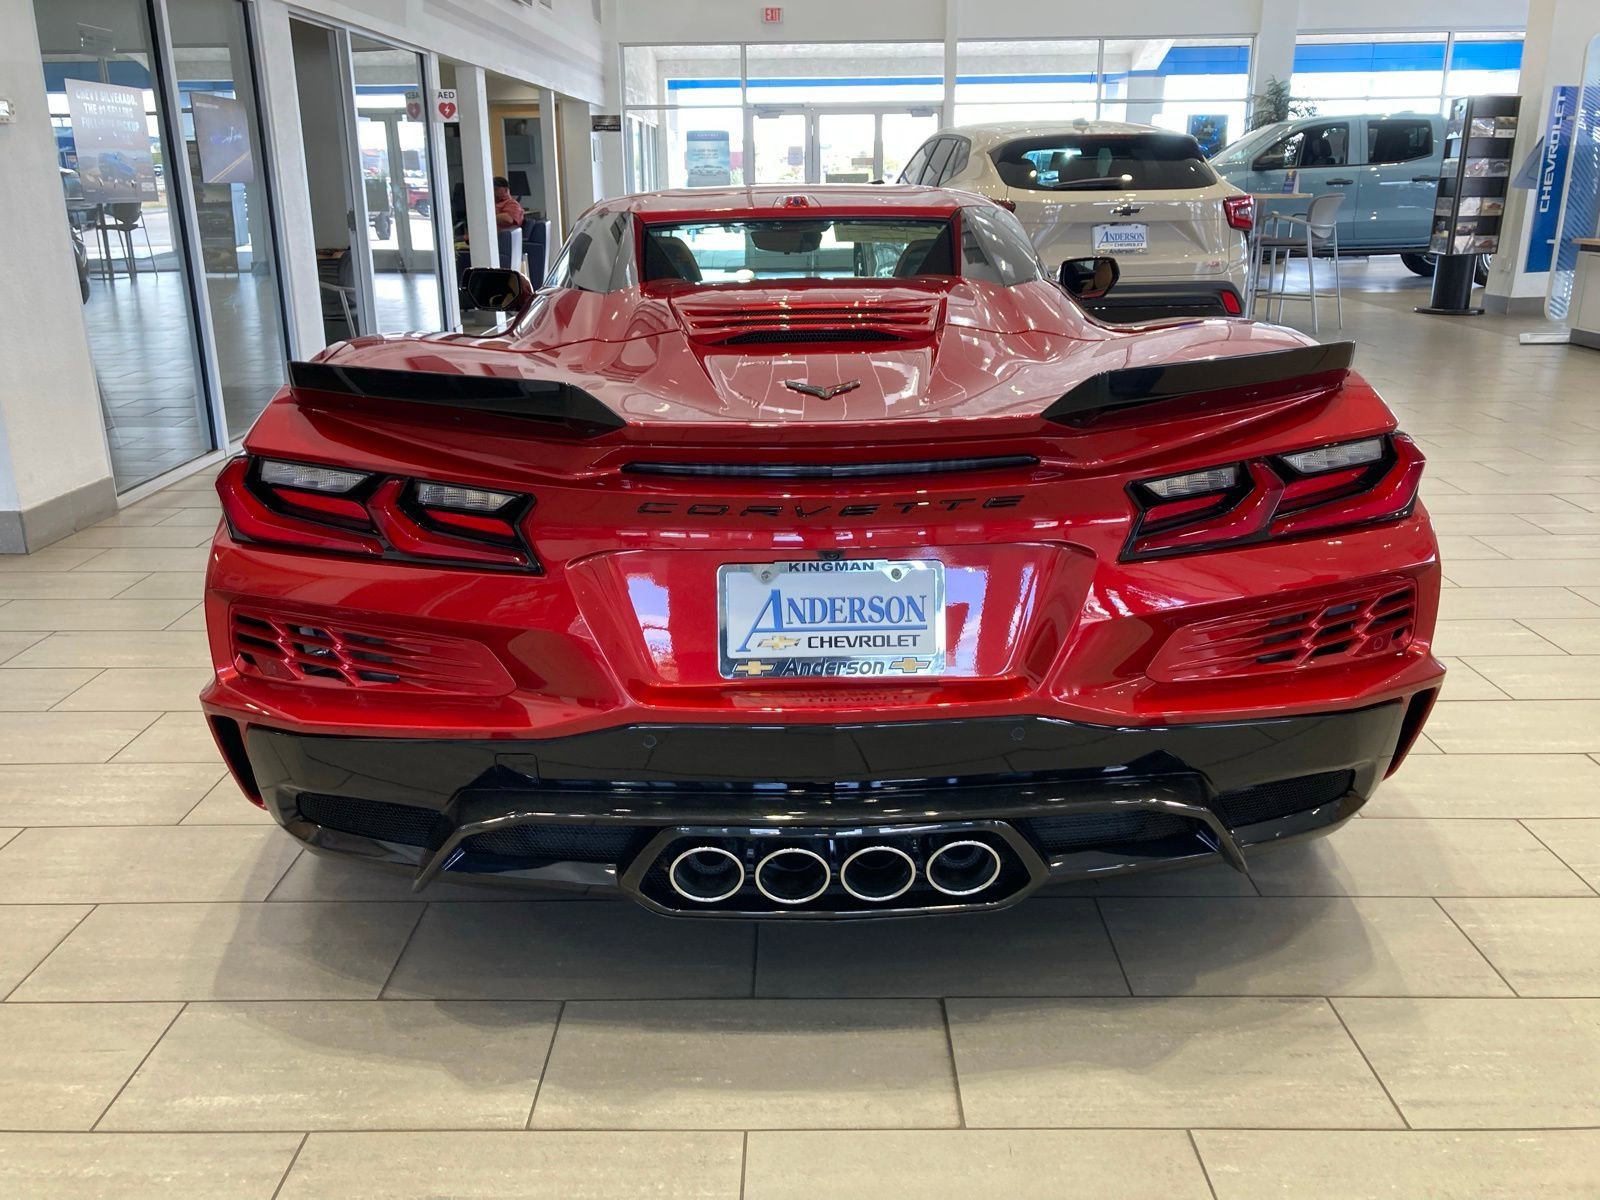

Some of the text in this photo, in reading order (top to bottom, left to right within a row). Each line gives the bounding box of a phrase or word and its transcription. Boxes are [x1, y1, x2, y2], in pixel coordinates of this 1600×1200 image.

[438, 91, 455, 99] AED
[1540, 92, 1567, 213] CHEVROLET
[1097, 231, 1145, 248] ANDERSON
[636, 494, 1025, 518] CORVETTE
[788, 561, 875, 573] KINGMAN
[735, 589, 928, 652] ANDERSON
[807, 634, 921, 649] CHEVROLET
[780, 658, 885, 676] Anderson
